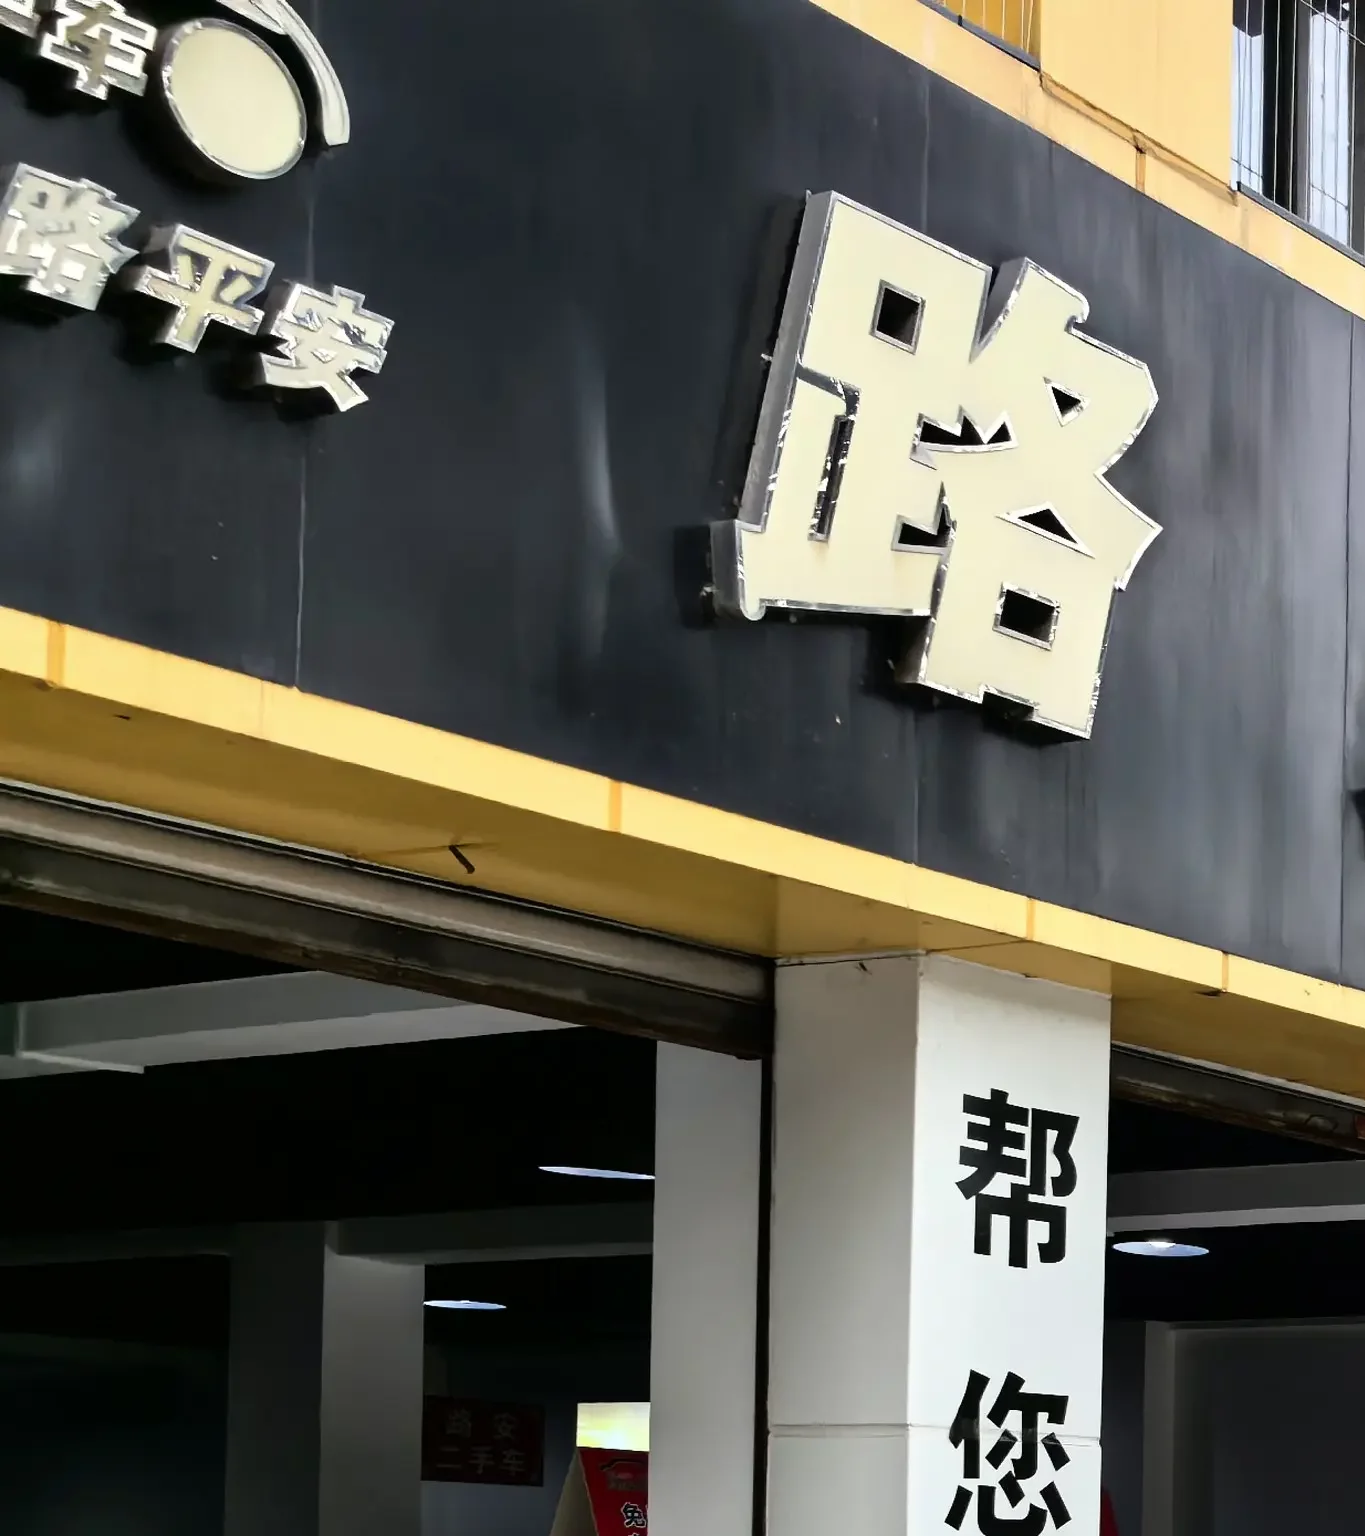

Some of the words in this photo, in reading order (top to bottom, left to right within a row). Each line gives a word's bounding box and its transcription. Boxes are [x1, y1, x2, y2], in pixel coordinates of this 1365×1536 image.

[435, 1444, 527, 1477] 二手车
[620, 1501, 648, 1529] 免
